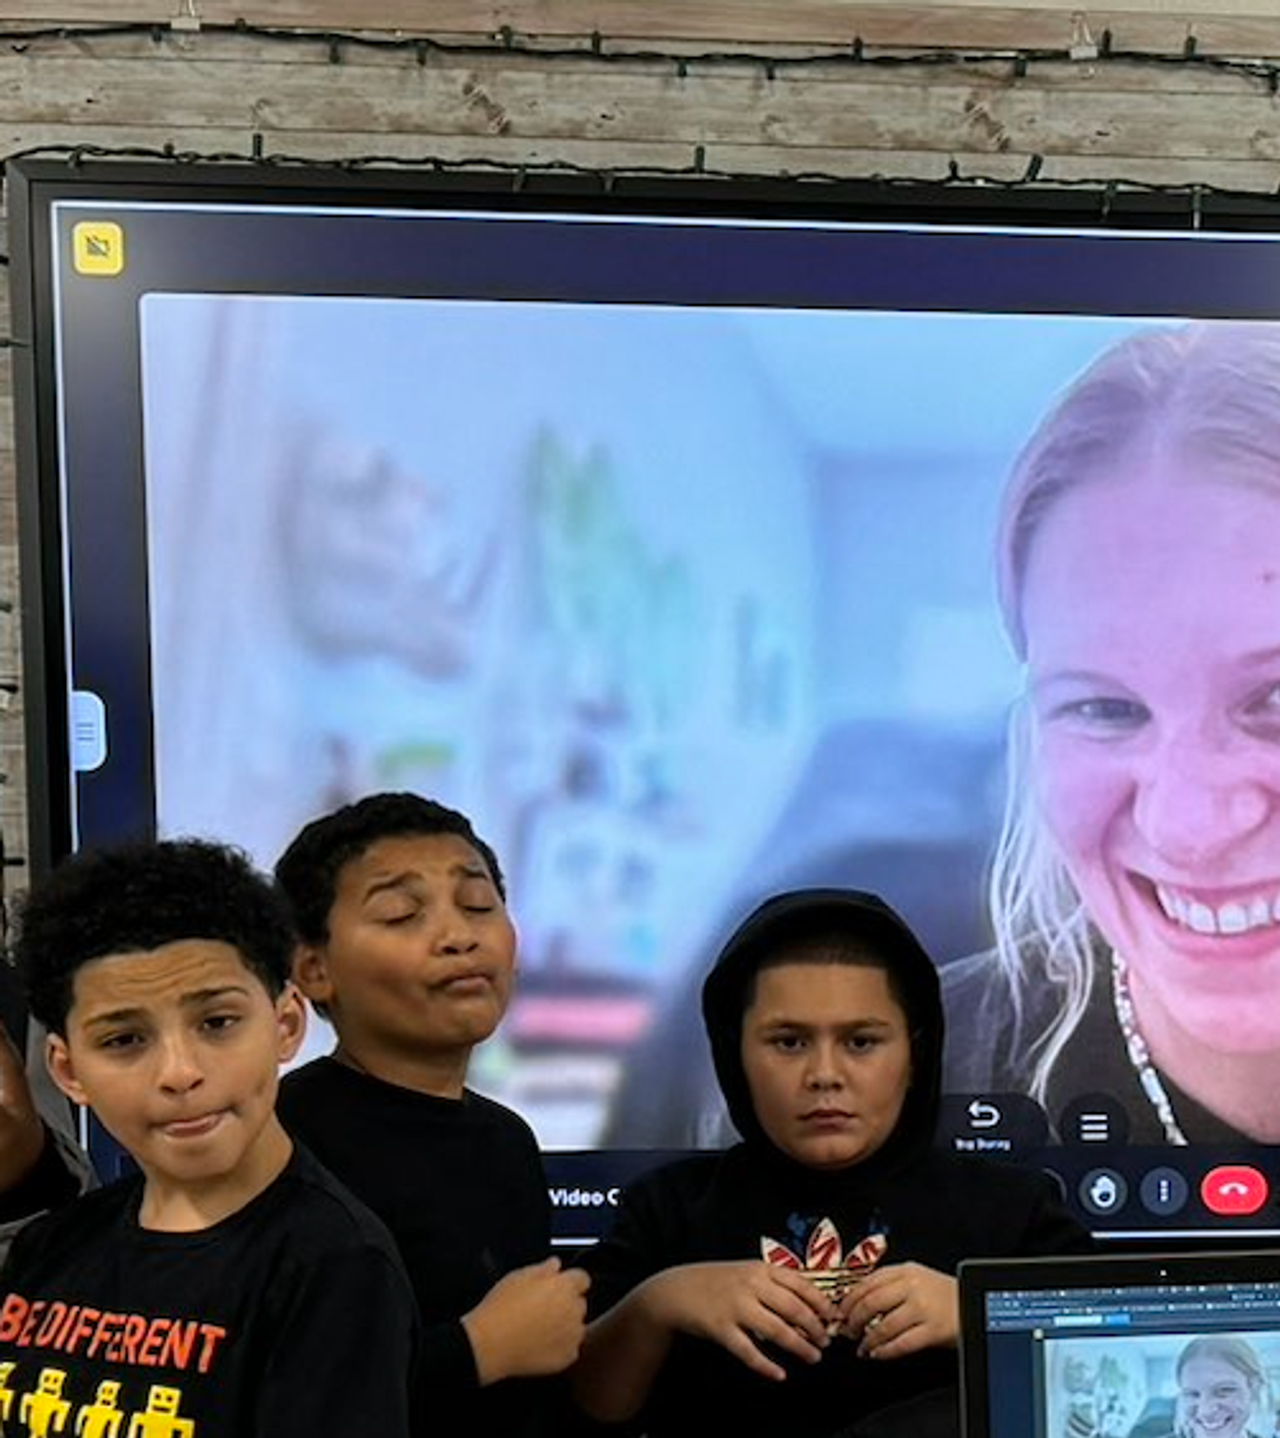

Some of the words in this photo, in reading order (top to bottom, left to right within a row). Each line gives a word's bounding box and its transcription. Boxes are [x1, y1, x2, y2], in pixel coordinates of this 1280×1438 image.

[548, 1187, 604, 1207] Video
[0, 1293, 46, 1348] BE
[35, 1301, 226, 1374] DIFFERENT
